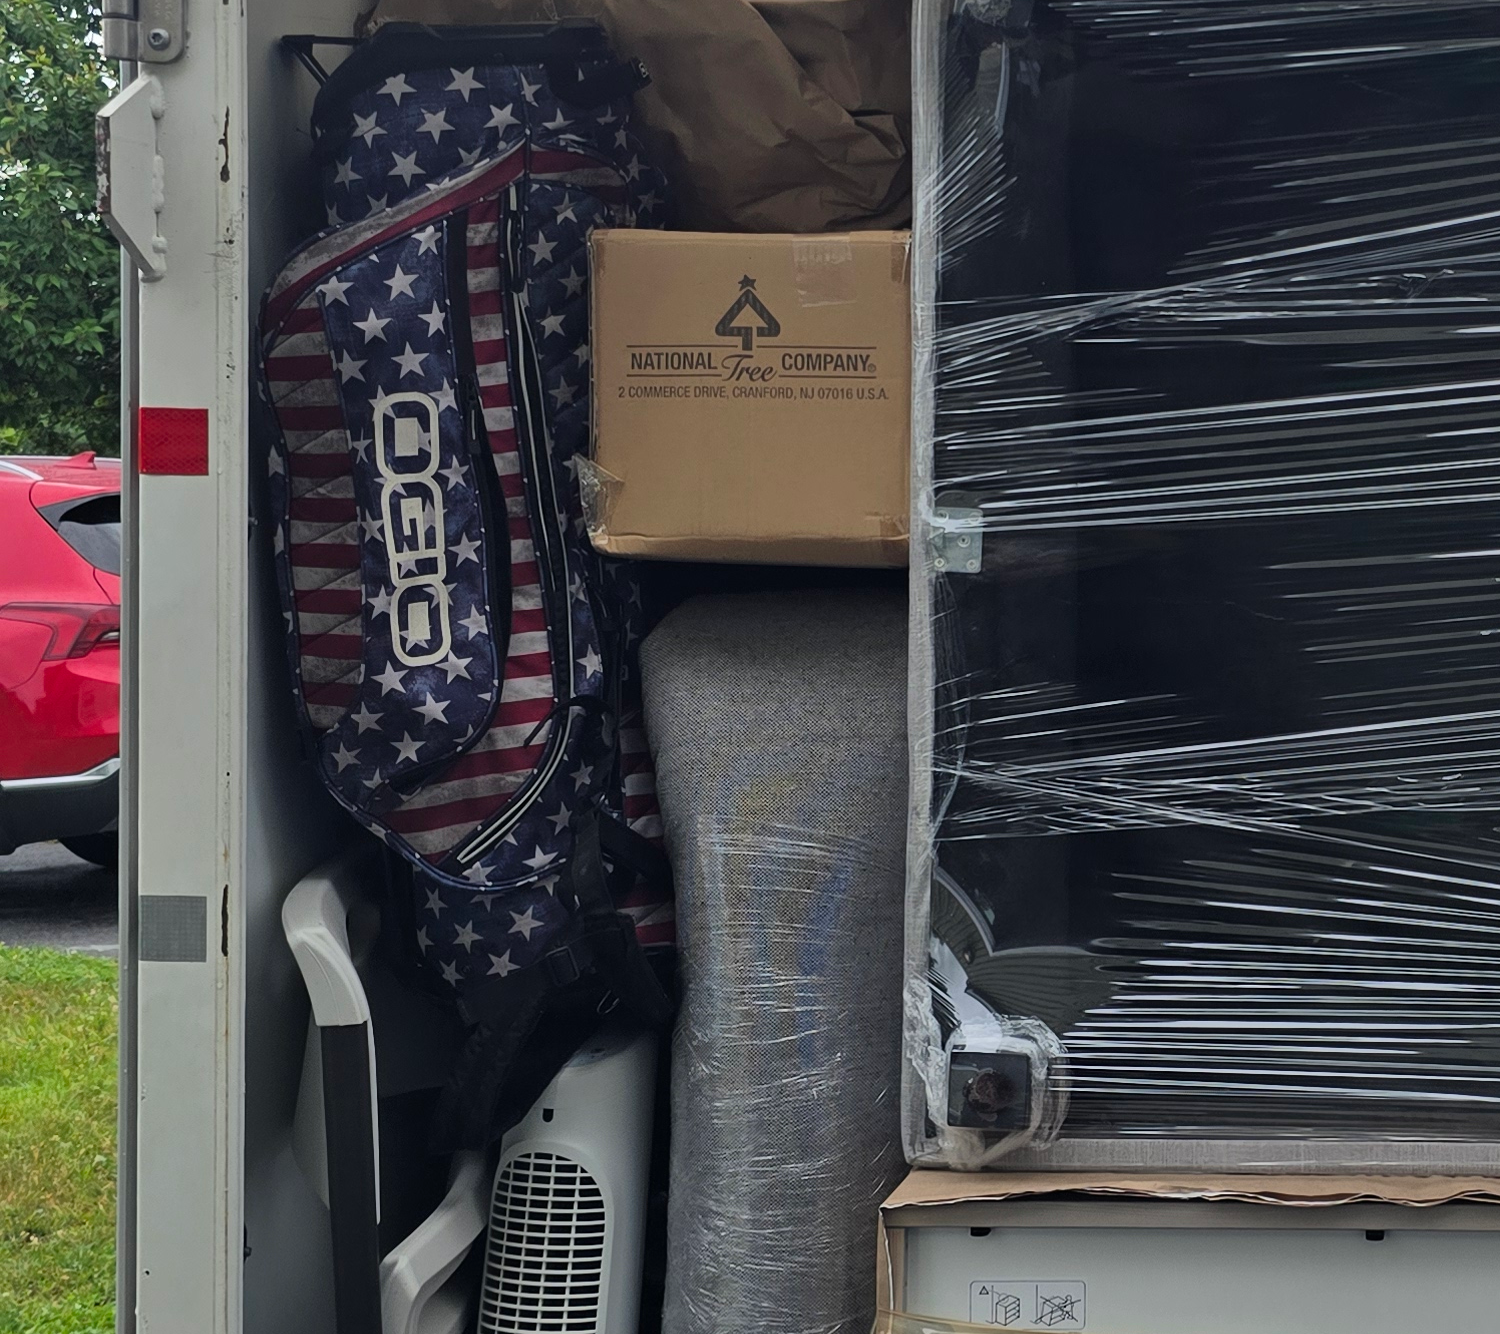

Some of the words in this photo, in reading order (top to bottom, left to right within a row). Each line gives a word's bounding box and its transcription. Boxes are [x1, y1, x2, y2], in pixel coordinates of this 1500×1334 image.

[631, 352, 718, 370] NATIONAL
[721, 354, 777, 382] Tree
[618, 386, 625, 398] 2
[628, 386, 691, 398] COMMERCE
[693, 386, 729, 399] DRIVE,
[732, 386, 797, 400] CRANFORD,
[800, 387, 815, 399] NJ
[817, 387, 853, 400] 07016
[856, 387, 889, 400] U.S.A.
[372, 390, 453, 667] OGIO
